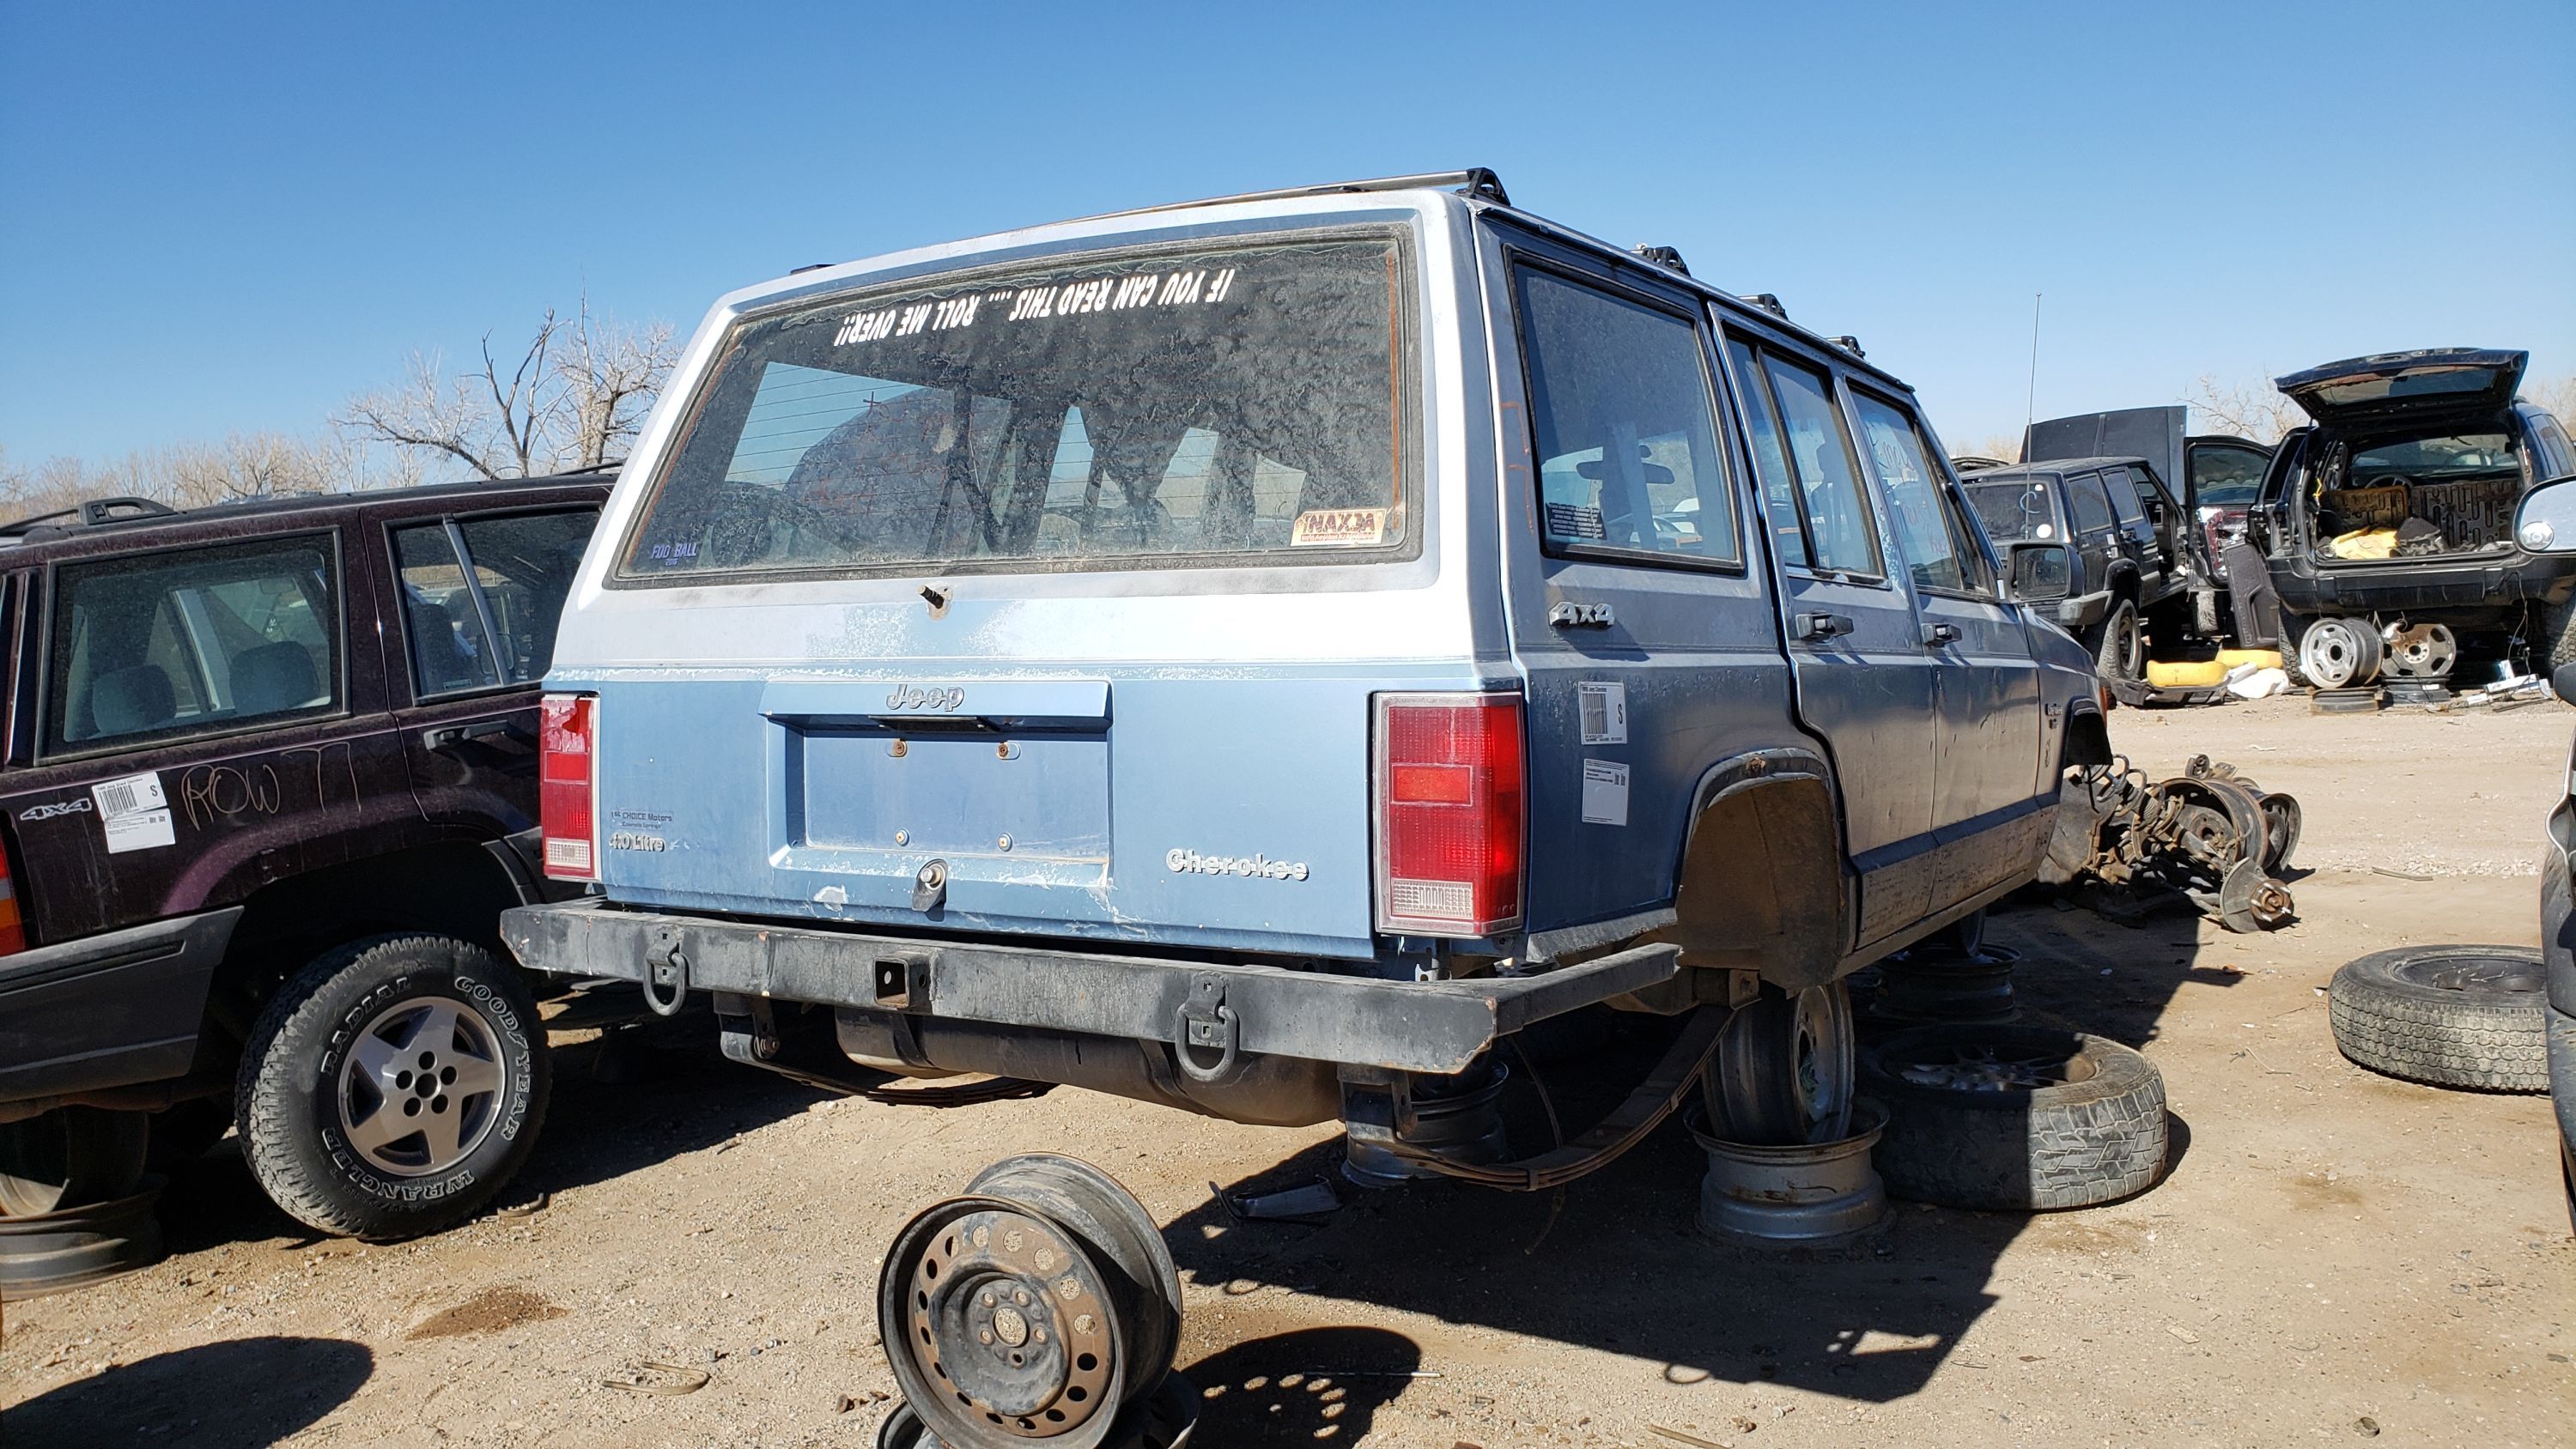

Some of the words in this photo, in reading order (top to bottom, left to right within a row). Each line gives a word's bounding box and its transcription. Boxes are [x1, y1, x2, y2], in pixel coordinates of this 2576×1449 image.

[1057, 280, 1114, 317] READ
[1112, 276, 1159, 311] CAN
[1157, 270, 1206, 306] YOU
[1205, 268, 1236, 304] IF
[833, 311, 896, 347] OVER!!
[896, 306, 932, 337] ME
[932, 294, 981, 332] ROLL
[673, 542, 697, 558] BALL
[886, 683, 965, 712] Jeep
[1618, 703, 1623, 724] S
[149, 784, 159, 797] S
[180, 763, 281, 833] ROW
[623, 811, 647, 821] CHOICE
[648, 813, 673, 822] Motors
[634, 834, 666, 852] Litre
[1165, 846, 1309, 882] Cherokee
[321, 976, 412, 1076] RADIAL
[454, 975, 532, 1141] GOODYEAR
[321, 1125, 476, 1202] WRANGLER
